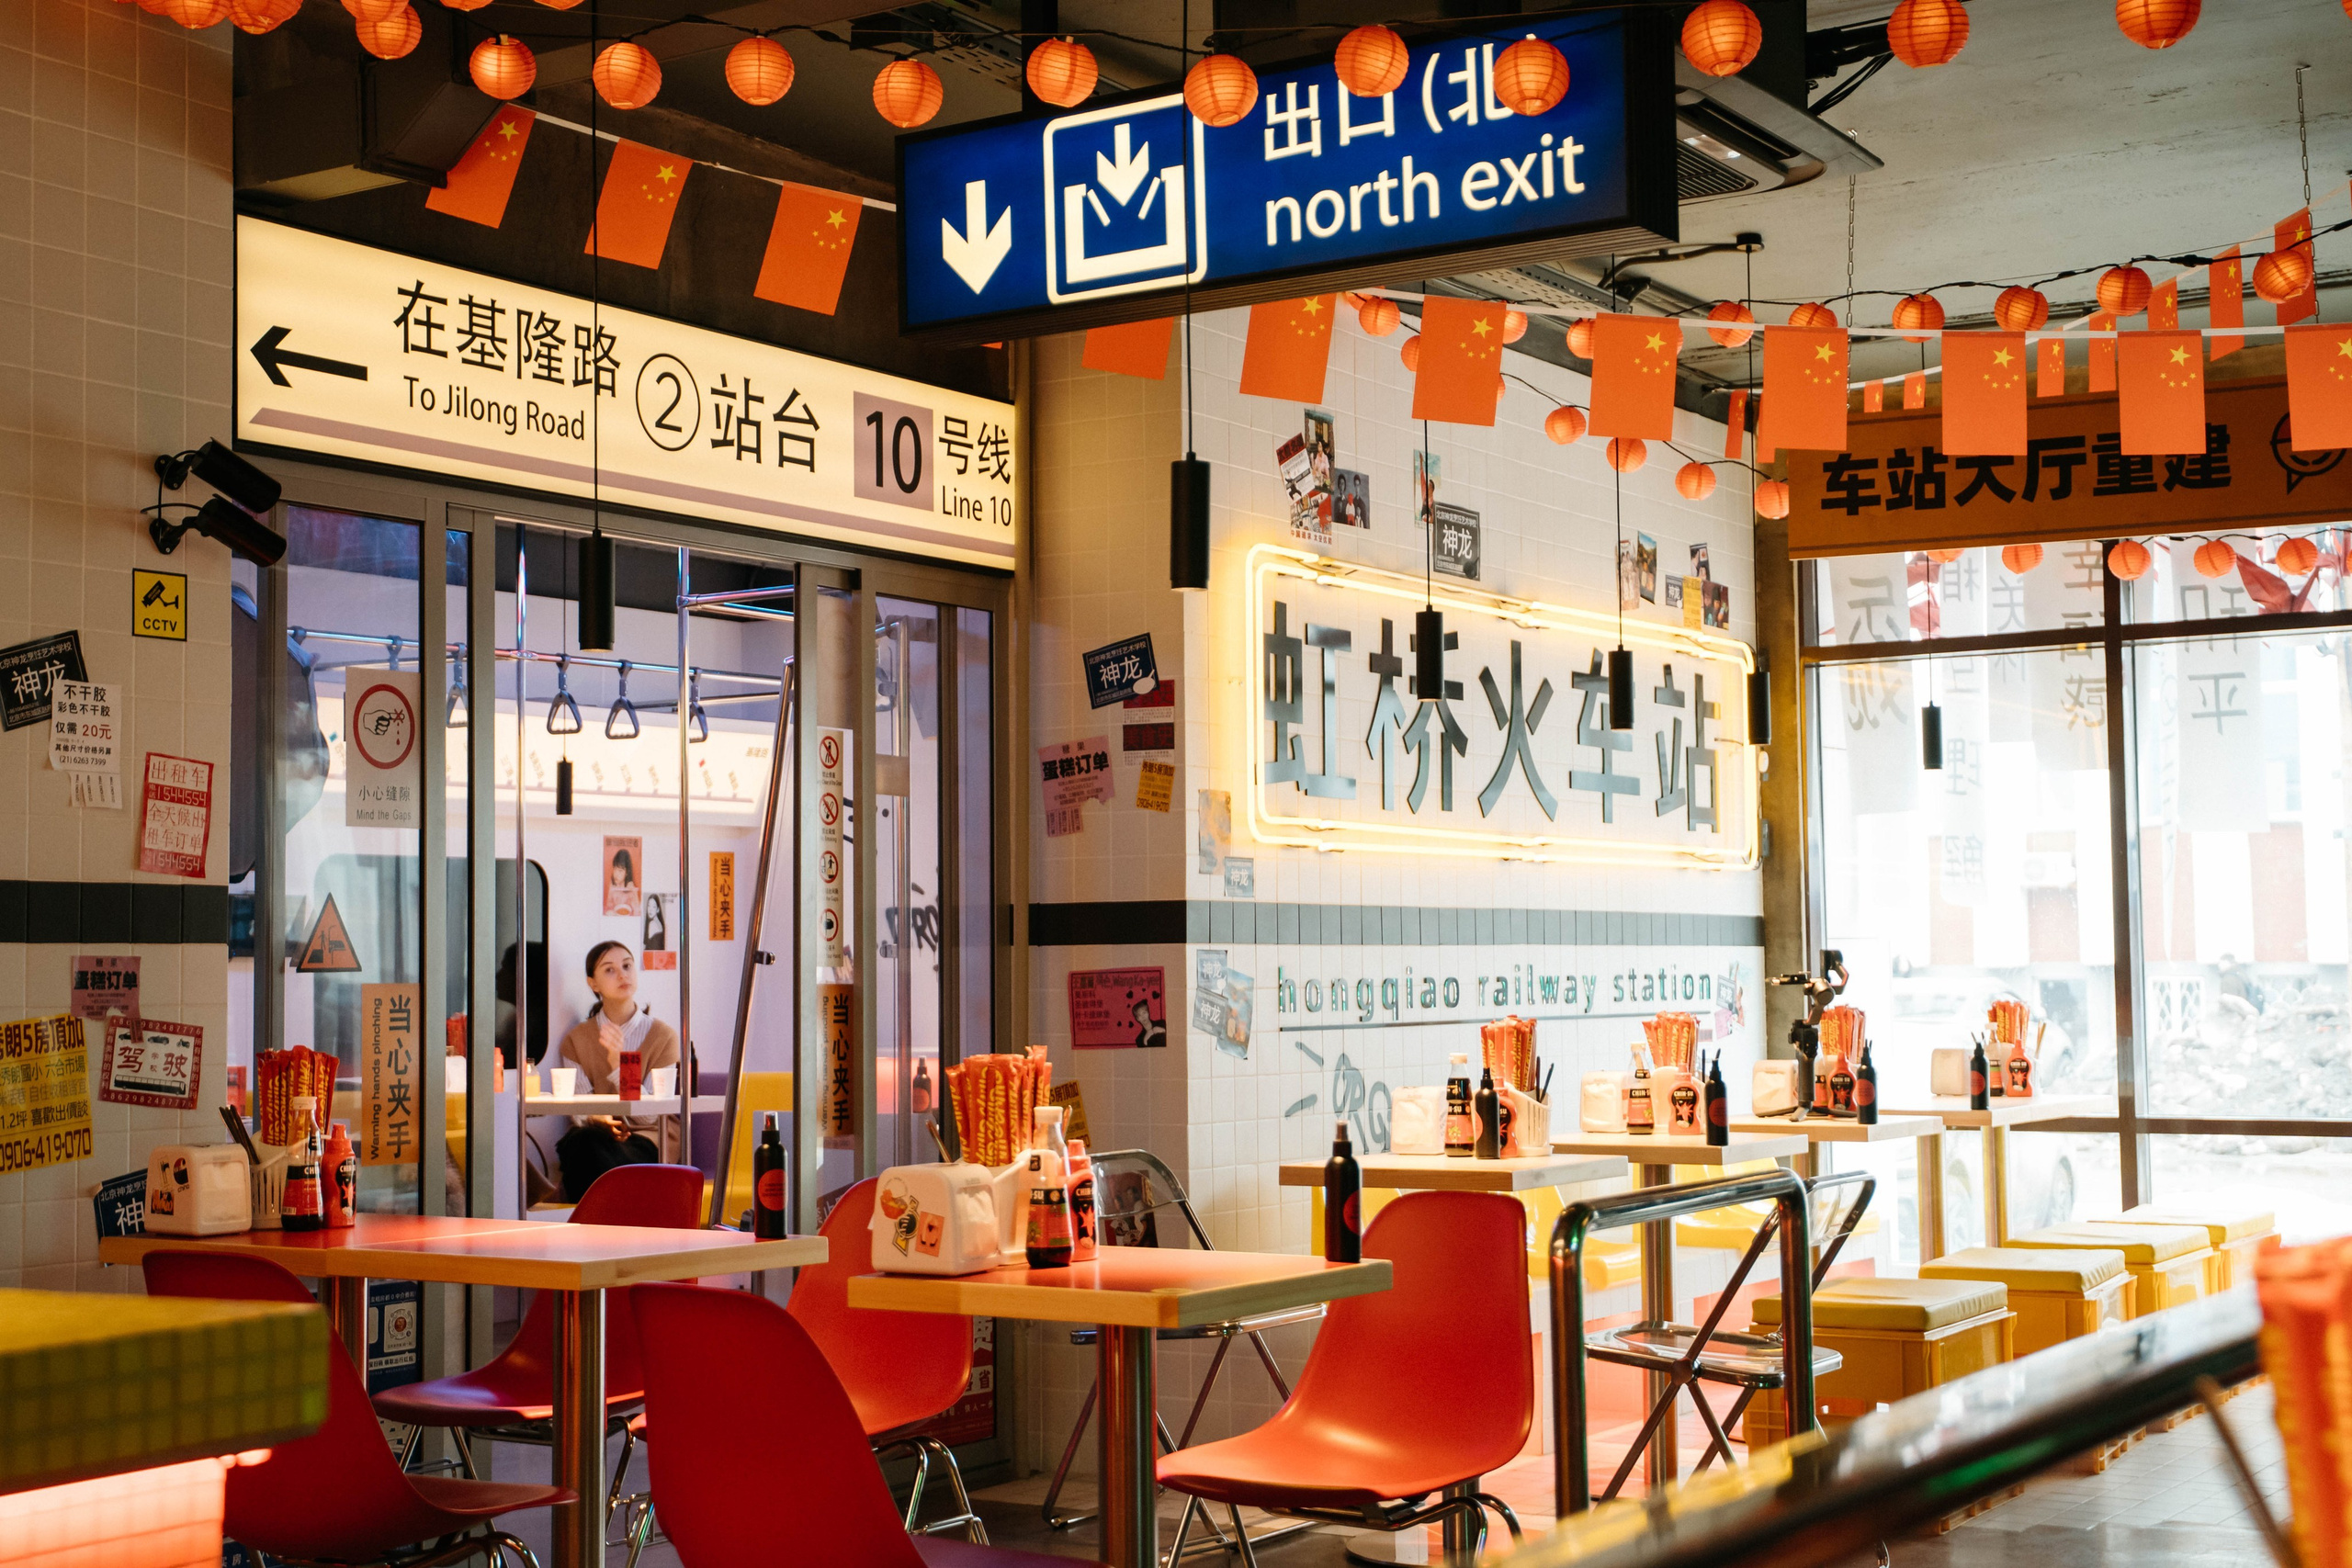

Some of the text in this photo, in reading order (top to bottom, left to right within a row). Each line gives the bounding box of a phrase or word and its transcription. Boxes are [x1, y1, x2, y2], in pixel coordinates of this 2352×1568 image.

[1266, 132, 1586, 246] north exit
[403, 377, 1012, 527] To Jilong Road Line 10
[865, 409, 923, 495] 10
[938, 415, 1012, 485] 号线
[1442, 524, 1473, 559] 神龙
[142, 617, 177, 632] CCTV
[1100, 655, 1143, 689] 神龙
[63, 683, 107, 703] 不干胶
[57, 701, 111, 717] 彩色不干胶
[1263, 601, 1721, 834] 虹桥火车站
[55, 721, 77, 735] 仅需
[82, 724, 112, 740] 20元
[74, 756, 89, 764] 6263
[90, 757, 107, 766] 7399
[152, 761, 205, 787] 出租车
[1043, 750, 1110, 781] 蛋糕订单
[157, 785, 207, 806] 1544554
[358, 784, 411, 802] 小心缝隙
[356, 808, 412, 823] Mind the Gaps
[74, 970, 138, 990] 蛋糕订单
[1278, 964, 1711, 1022] hongqiao railway station
[386, 993, 413, 1160] 当心夹手
[831, 992, 851, 1131] 当心夹手
[370, 998, 384, 1160] Warning hands pinching
